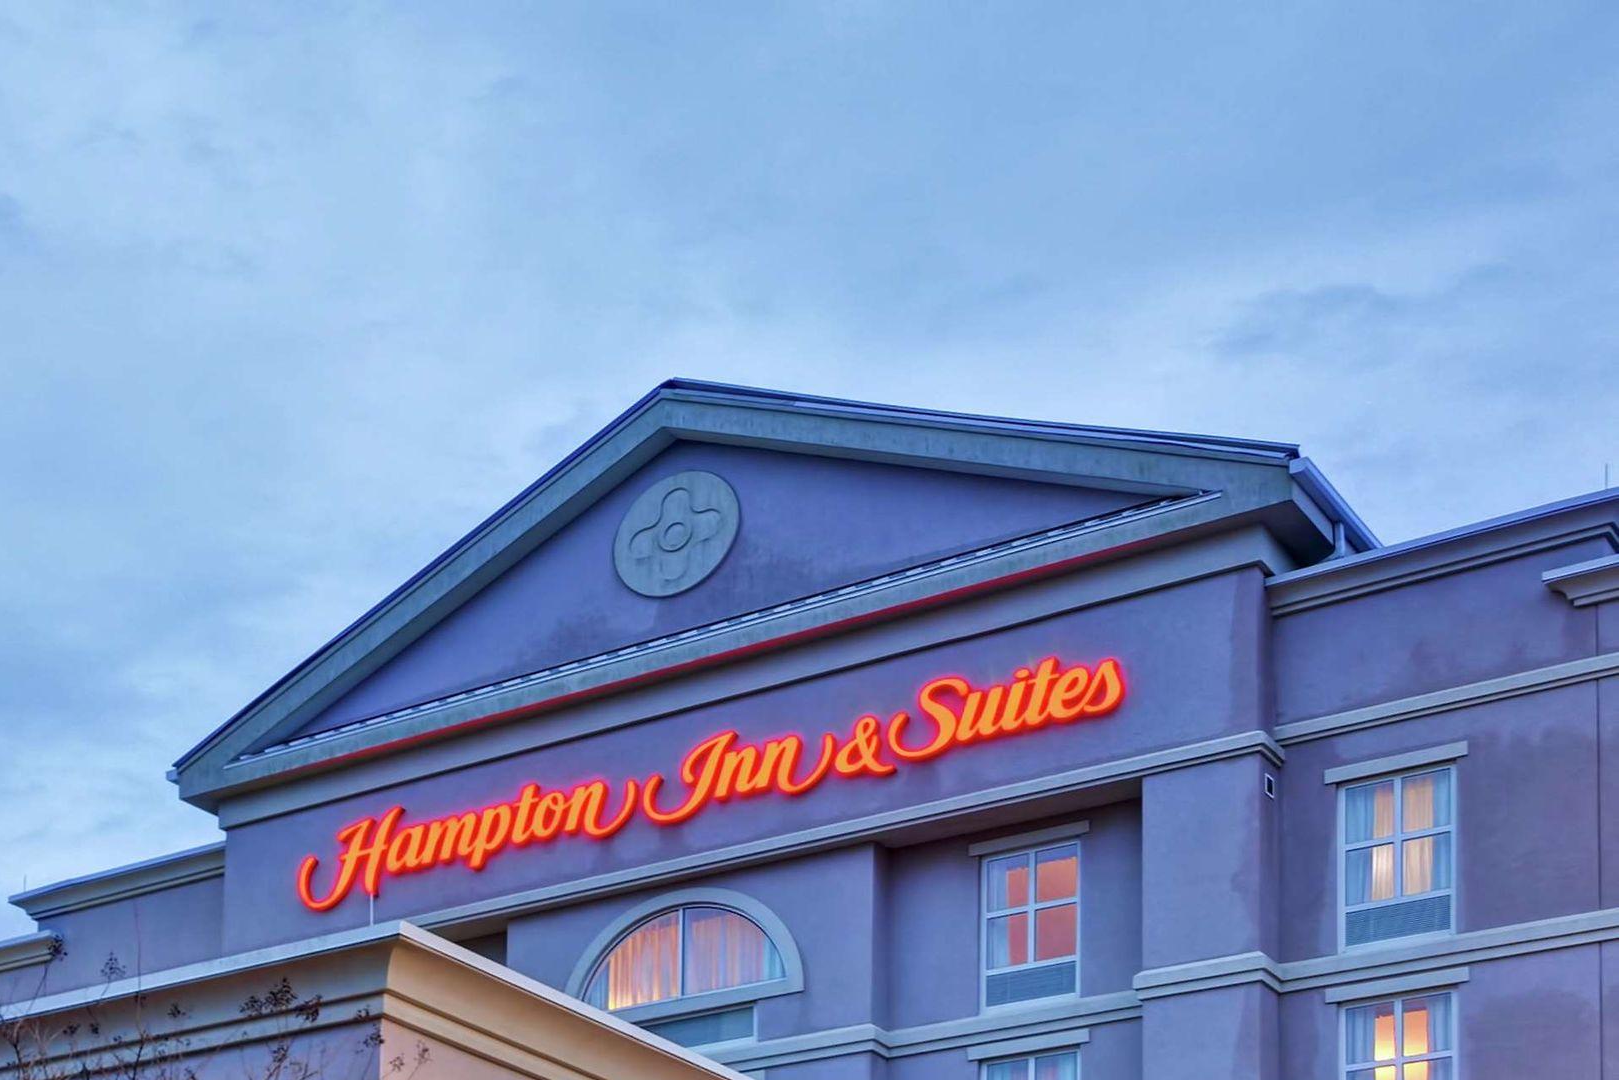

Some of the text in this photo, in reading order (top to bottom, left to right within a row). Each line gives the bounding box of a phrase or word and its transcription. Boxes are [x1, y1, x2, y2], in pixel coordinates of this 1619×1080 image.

[297, 656, 1125, 912] Hampton Inn & Suites
